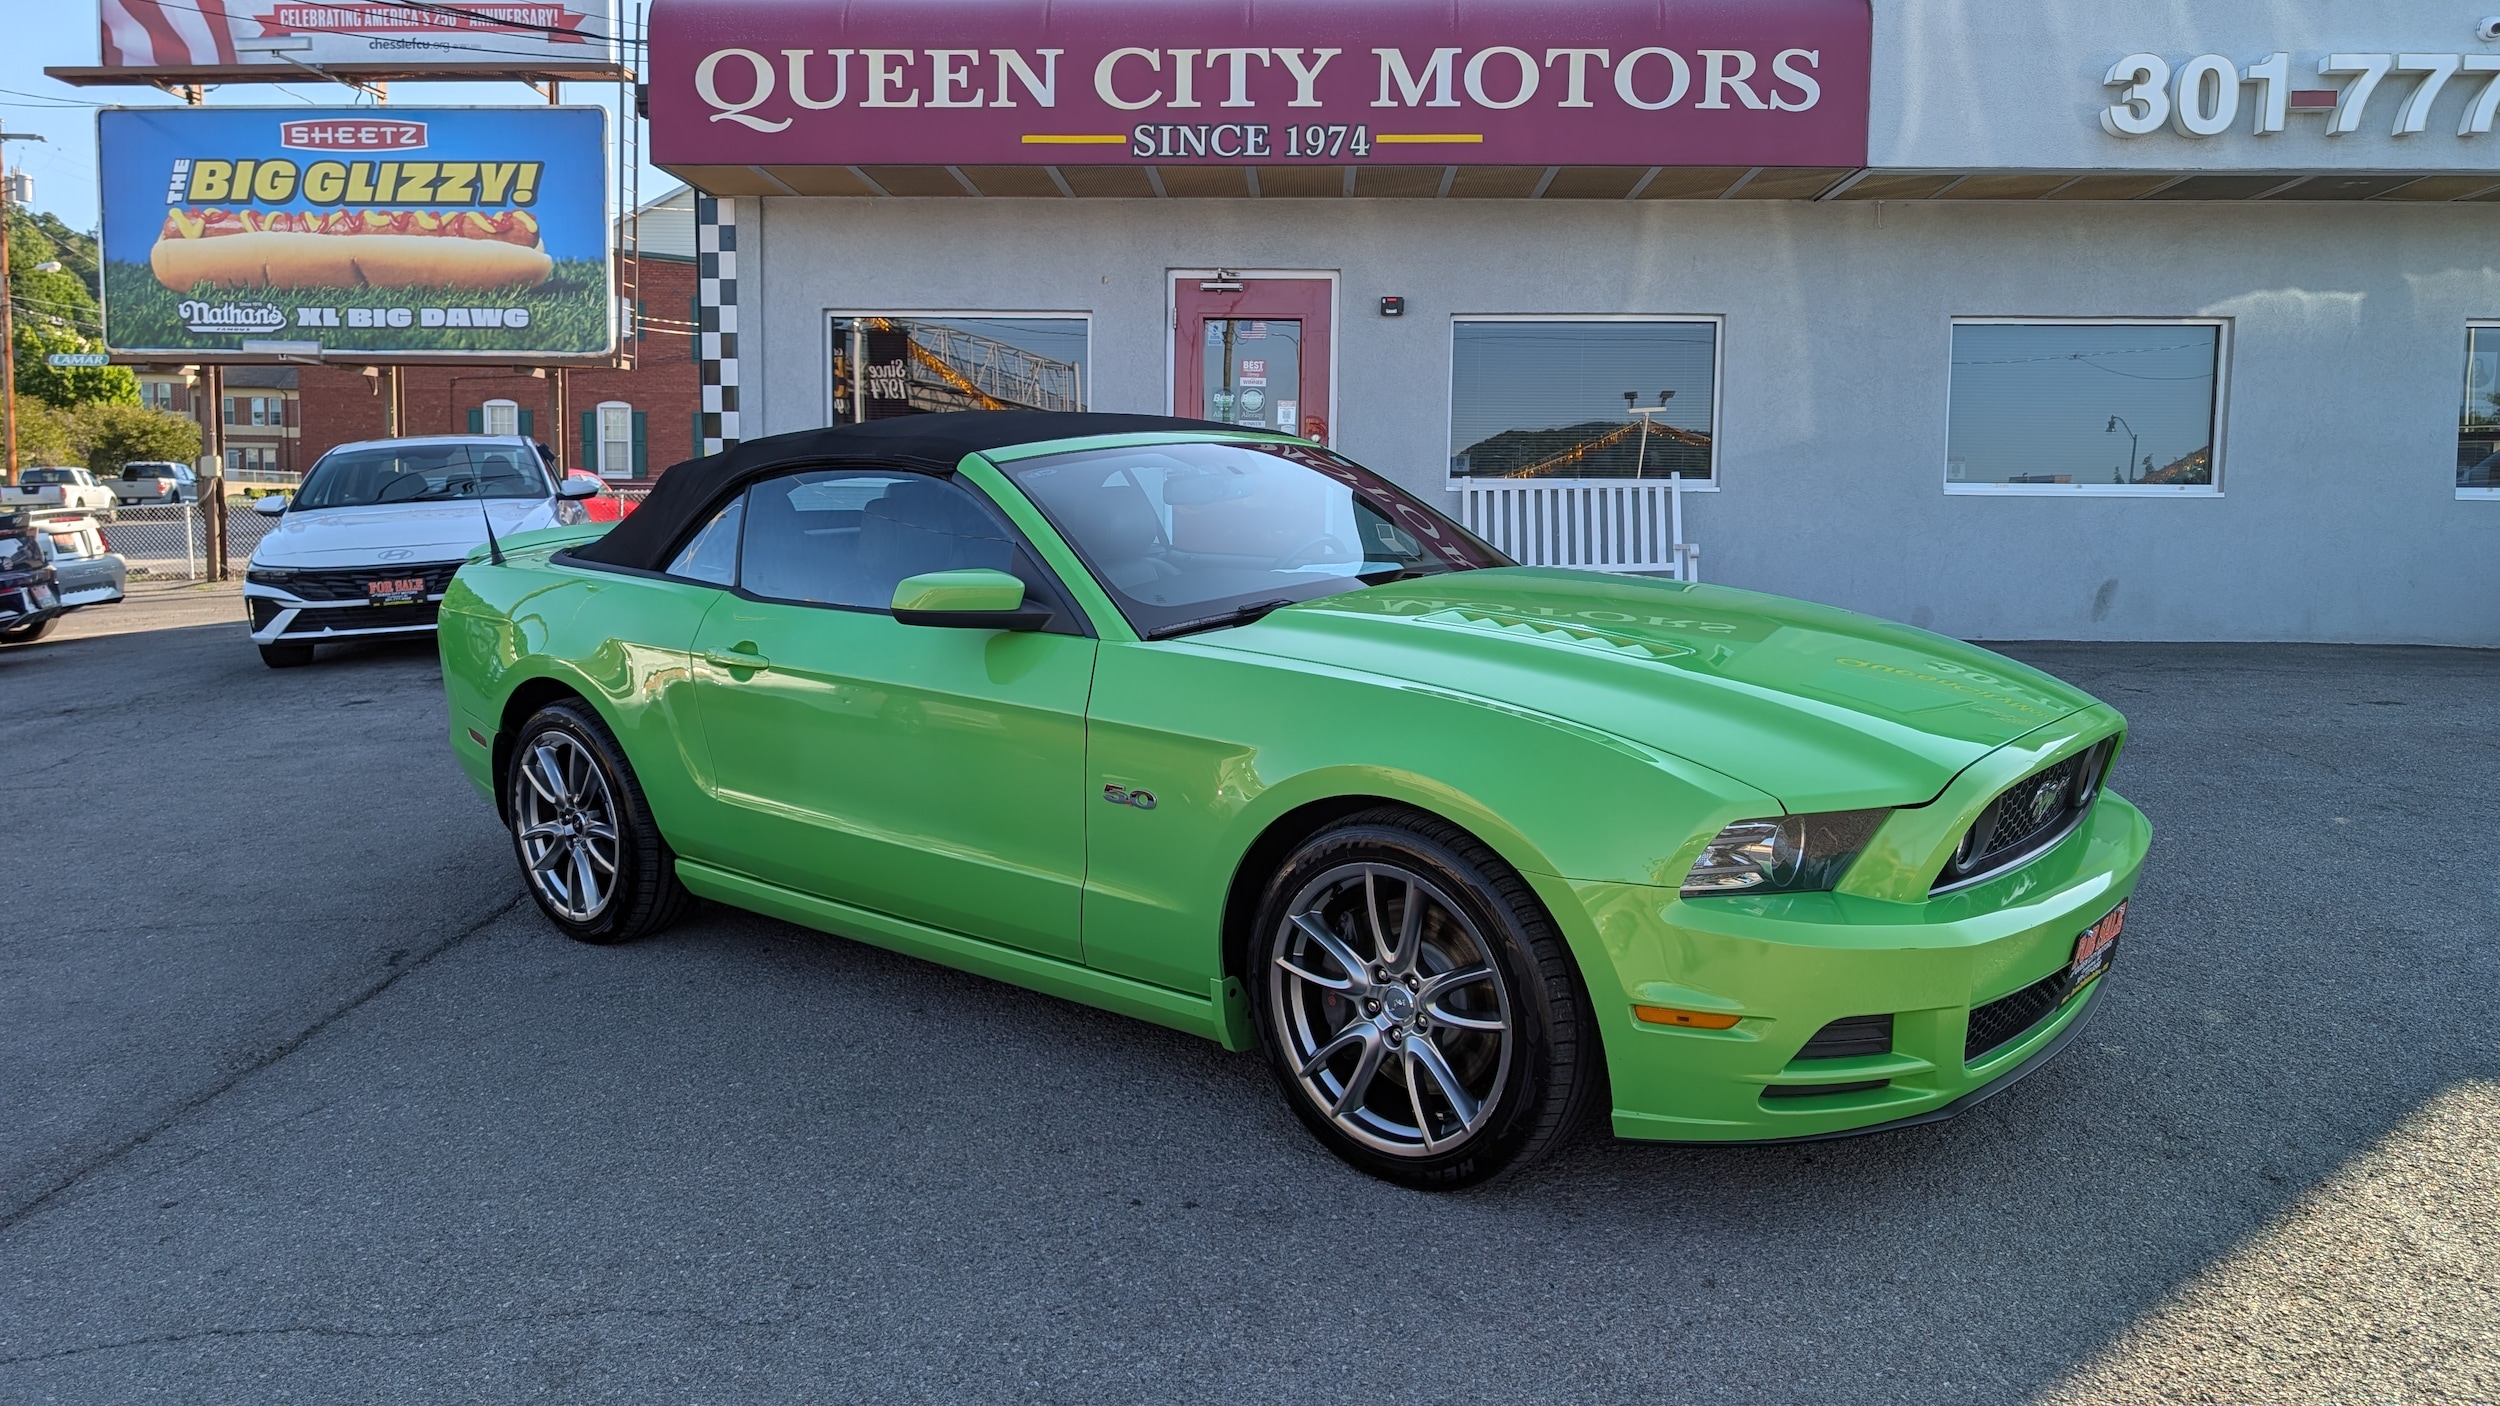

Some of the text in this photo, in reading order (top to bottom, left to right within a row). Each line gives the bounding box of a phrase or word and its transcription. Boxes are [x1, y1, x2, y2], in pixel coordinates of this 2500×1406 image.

[280, 9, 361, 27] CELEBRATING
[364, 8, 430, 27] AMERICA'S
[469, 8, 559, 27] ANNIVERSARY!
[694, 45, 1822, 133] QUEEN CITY MOTORS
[290, 126, 418, 144] SHEETZ
[1132, 123, 1371, 158] SINCE 1974
[166, 158, 191, 205] THE
[187, 159, 540, 204] BIG GLIZZY!
[178, 300, 287, 325] Nathan's
[297, 308, 531, 328] XL BIG DAWG
[53, 356, 104, 364] LAMAR
[1243, 360, 1264, 369] BEST
[368, 581, 393, 594] FOR
[394, 578, 424, 591] SALE
[1103, 782, 1157, 811] 5.0
